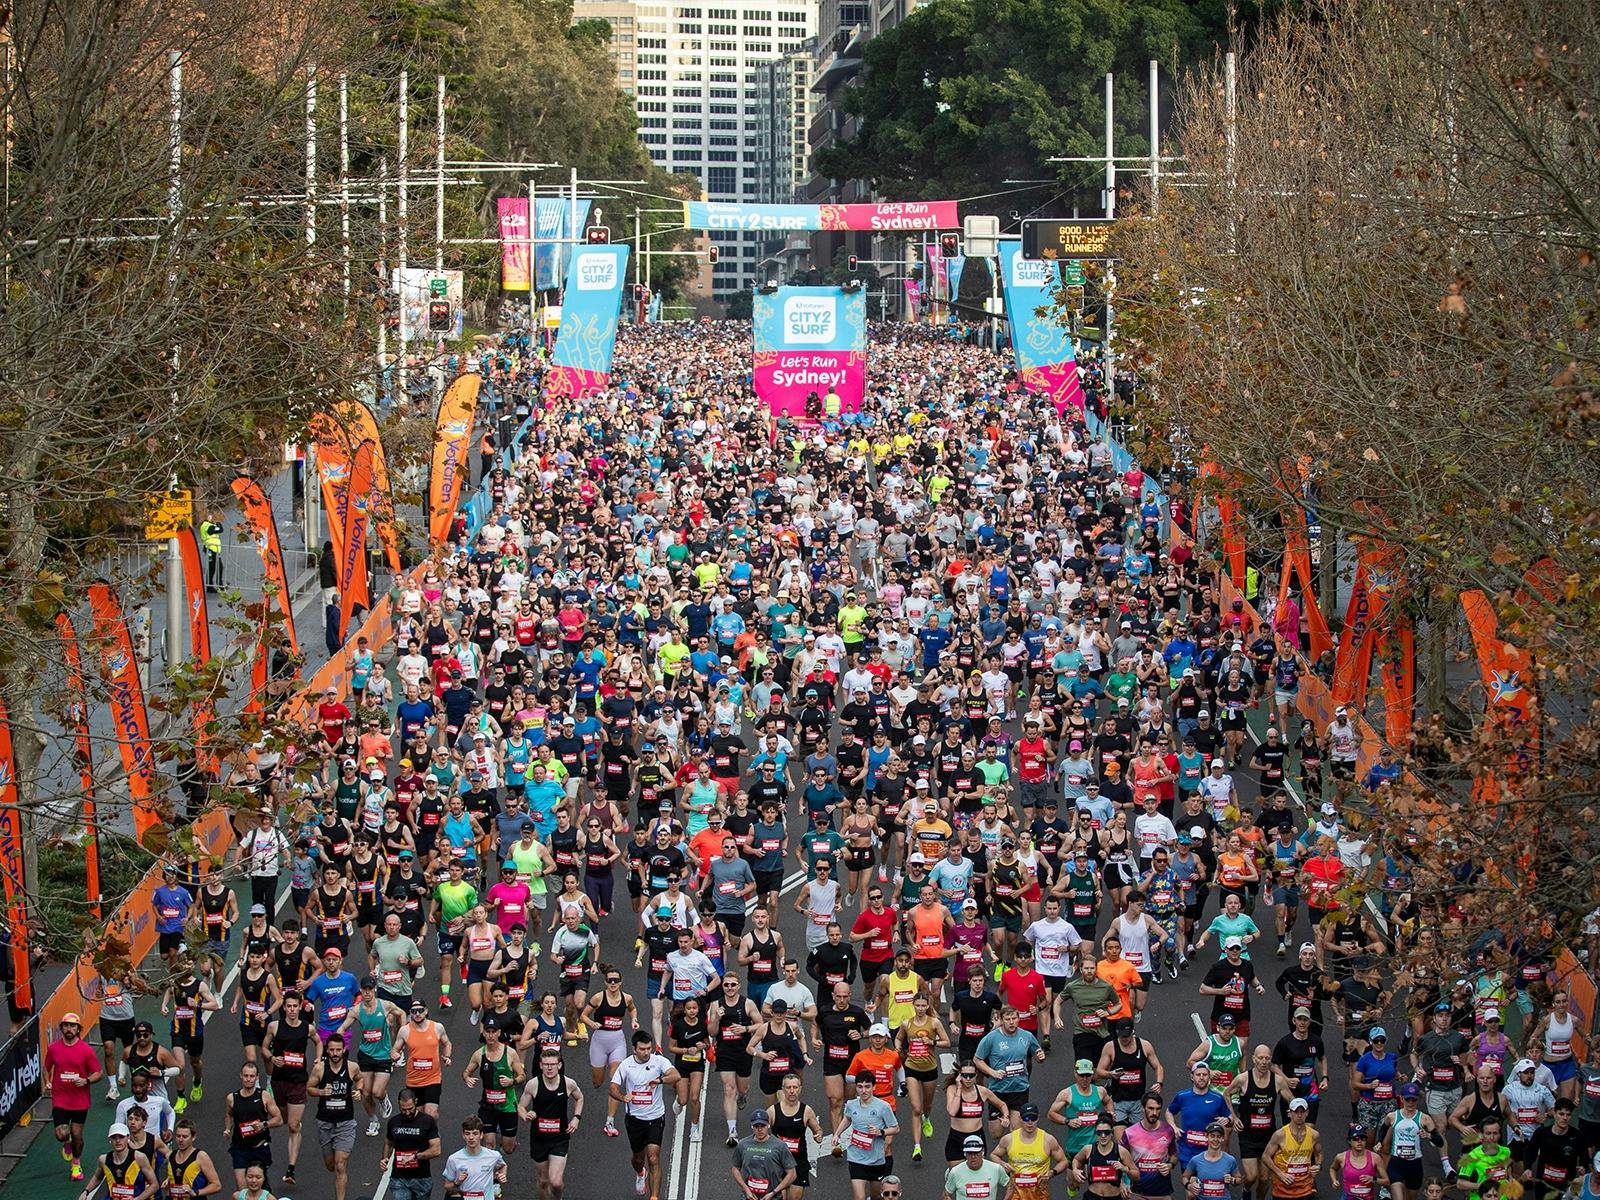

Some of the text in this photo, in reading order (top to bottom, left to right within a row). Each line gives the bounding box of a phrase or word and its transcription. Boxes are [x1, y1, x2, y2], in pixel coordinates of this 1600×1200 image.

[877, 203, 928, 214] Let's Run
[871, 214, 938, 229] Sydney!
[1060, 226, 1082, 235] GOOD
[1065, 243, 1104, 252] RUNNERS
[581, 264, 614, 274] CITY2
[583, 275, 612, 283] SURF
[789, 311, 831, 323] CITY2
[792, 324, 829, 335] SURF
[781, 356, 837, 368] Let's Run
[772, 369, 847, 387] Sydney!
[441, 439, 462, 503] Voltaren
[343, 517, 366, 592] Voltaren
[0, 1043, 40, 1117] ebel rebel
